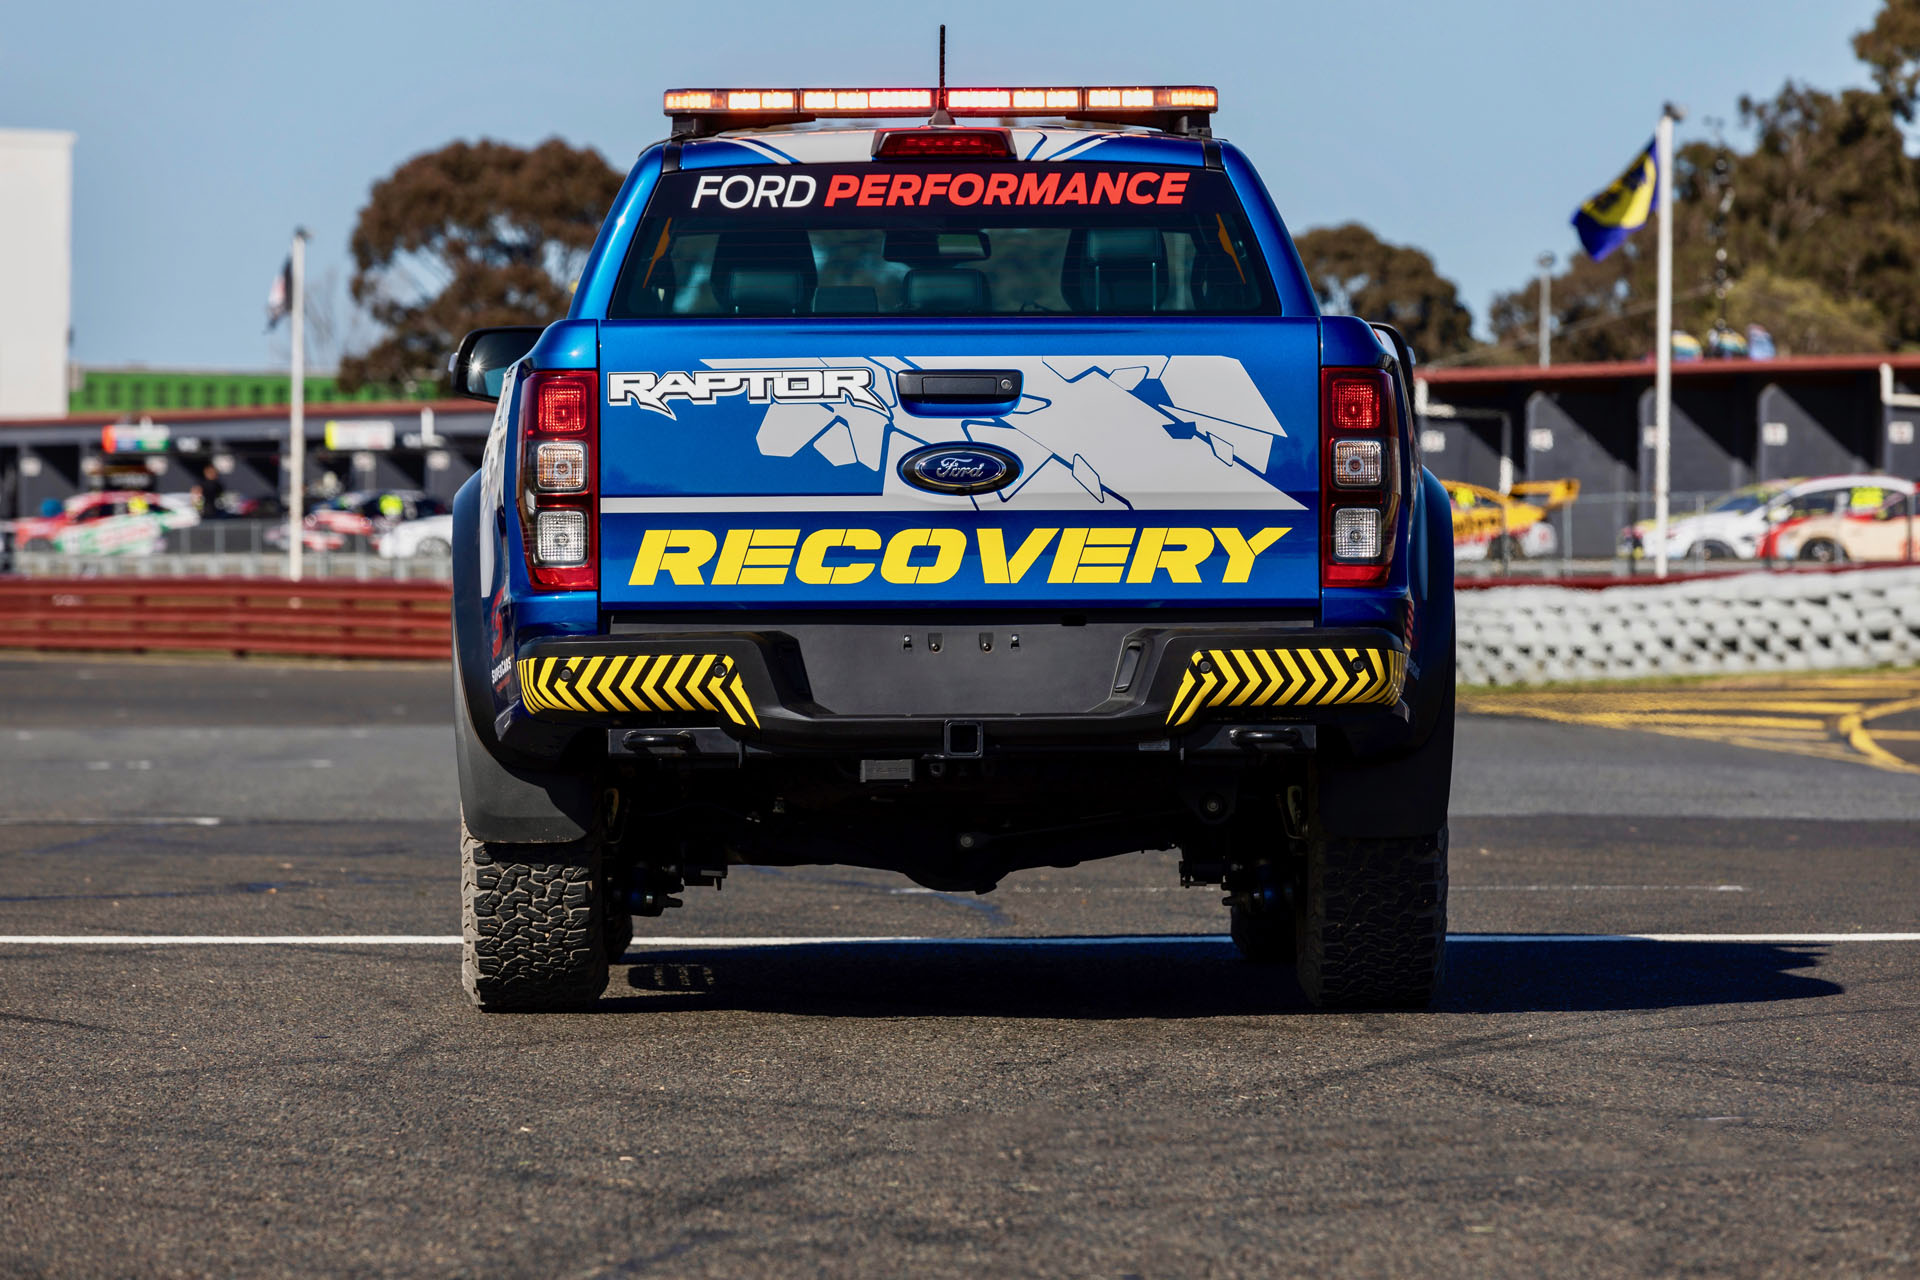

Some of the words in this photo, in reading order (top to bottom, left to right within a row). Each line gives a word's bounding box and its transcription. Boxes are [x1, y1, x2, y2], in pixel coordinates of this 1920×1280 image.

[691, 174, 817, 209] FORD
[824, 171, 1191, 207] PERFORMANCE
[608, 370, 890, 420] RAPTOR
[936, 457, 985, 478] Ford
[628, 527, 1293, 586] RECOVERY
